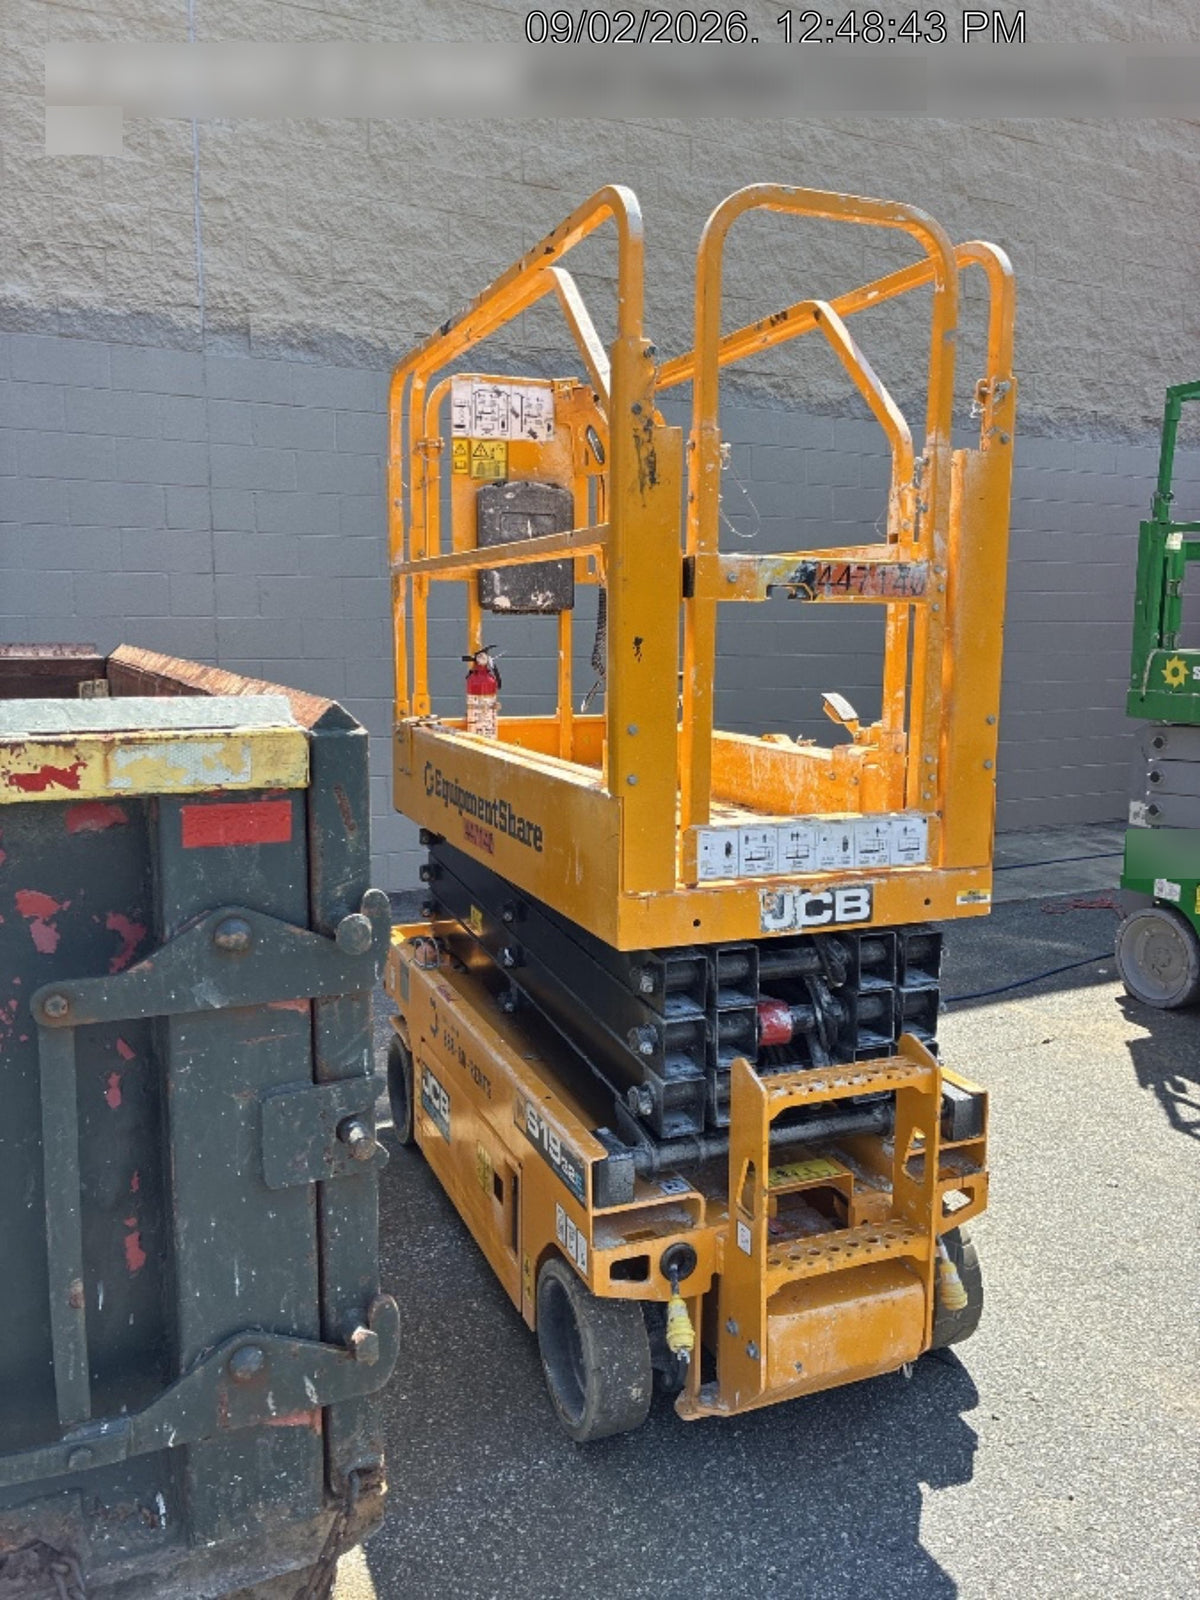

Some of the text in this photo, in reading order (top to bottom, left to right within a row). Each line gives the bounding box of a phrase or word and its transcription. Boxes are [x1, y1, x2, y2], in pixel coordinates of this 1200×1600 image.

[434, 768, 543, 853] EquipmentShare
[759, 888, 871, 930] JCB
[422, 1069, 450, 1122] JCB
